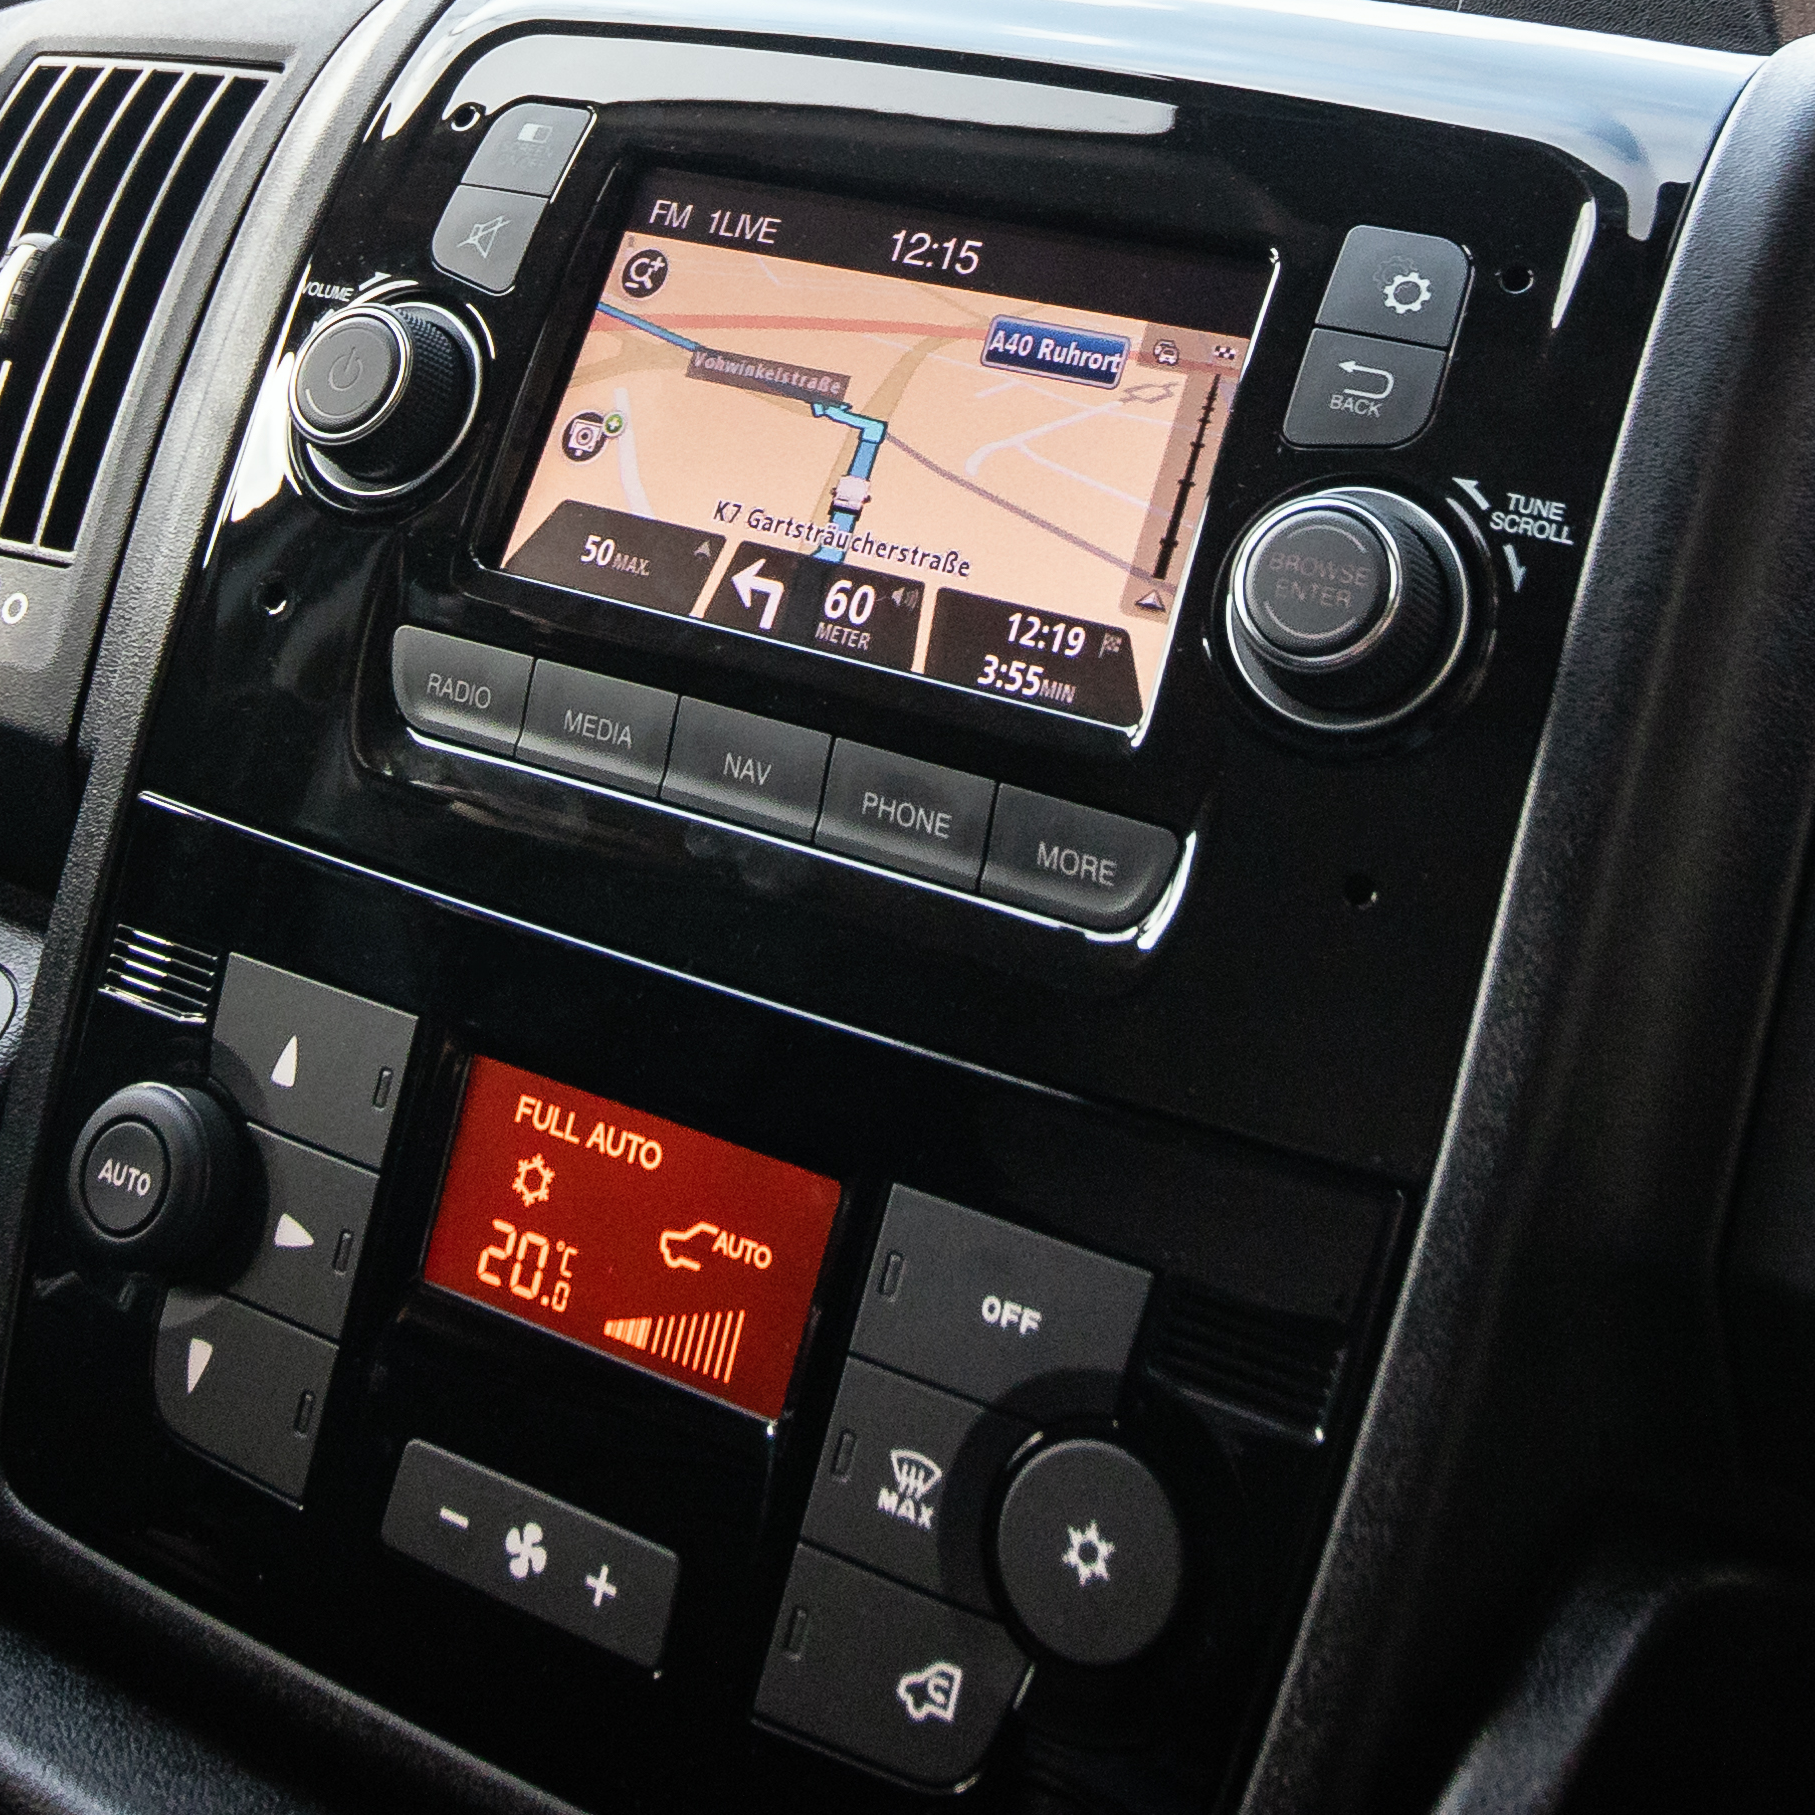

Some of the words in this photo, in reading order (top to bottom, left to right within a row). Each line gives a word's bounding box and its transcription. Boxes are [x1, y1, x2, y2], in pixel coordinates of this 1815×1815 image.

[648, 199, 694, 230] FM
[708, 208, 783, 245] 1LIVE
[889, 228, 984, 276] 12:15
[301, 281, 355, 303] VOLUME
[693, 349, 842, 395] Vohwinkelstraße
[989, 330, 1033, 358] A40
[1036, 336, 1123, 374] Ruhrort
[1328, 393, 1383, 419] BACK
[1488, 510, 1575, 545] SCROLL
[1506, 492, 1567, 522] TUNE
[712, 500, 742, 525] K7
[746, 508, 972, 579] Gartsträucherstraße
[1268, 553, 1372, 586] BROWSE
[823, 578, 876, 626] 60
[1273, 581, 1354, 610] ENTER
[815, 621, 871, 652] METER
[1006, 611, 1087, 659] 12:19
[425, 672, 492, 710] RADIO
[563, 709, 633, 751] MEDIA
[723, 751, 772, 787] NAV
[861, 791, 953, 840] PHONE
[1036, 840, 1118, 888] MORE
[513, 1093, 582, 1146] FULL
[584, 1121, 664, 1171] AUTO
[97, 1157, 152, 1198] AUTO
[711, 1230, 774, 1271] AUTO
[981, 1294, 1043, 1336] OFF
[876, 1486, 937, 1532] MAX
